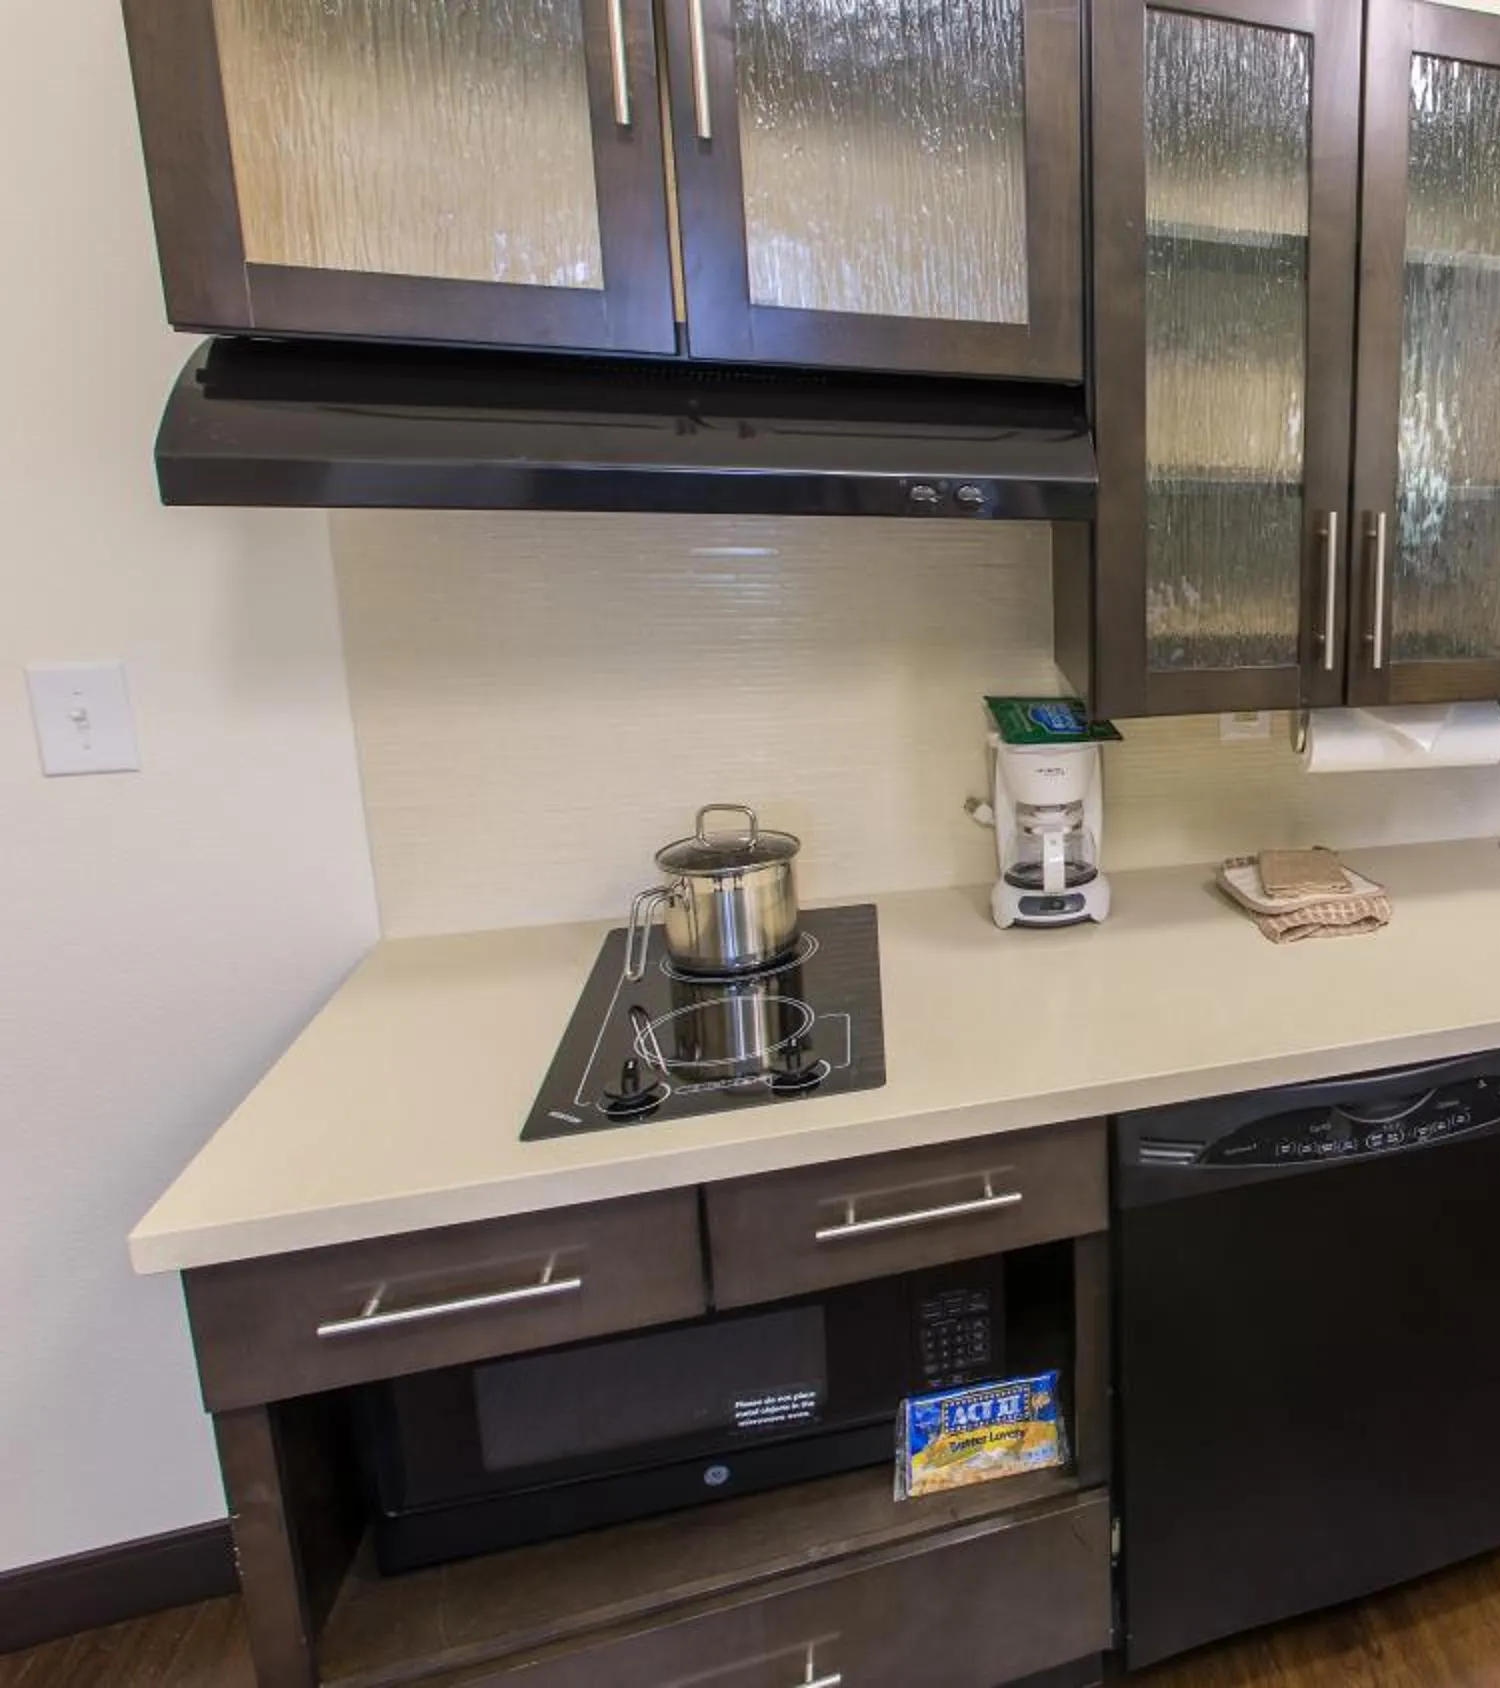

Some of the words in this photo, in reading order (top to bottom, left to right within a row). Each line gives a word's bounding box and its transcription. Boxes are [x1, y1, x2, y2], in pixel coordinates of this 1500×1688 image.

[735, 1400, 762, 1408] Please
[764, 1396, 776, 1405] do
[777, 1394, 792, 1402] not
[793, 1391, 816, 1401] place
[735, 1408, 759, 1418] metal
[760, 1404, 790, 1415] objects
[792, 1402, 800, 1410] in
[801, 1401, 815, 1409] the
[952, 1399, 994, 1426] ACT
[997, 1395, 1021, 1417] II
[949, 1435, 987, 1453] Butter
